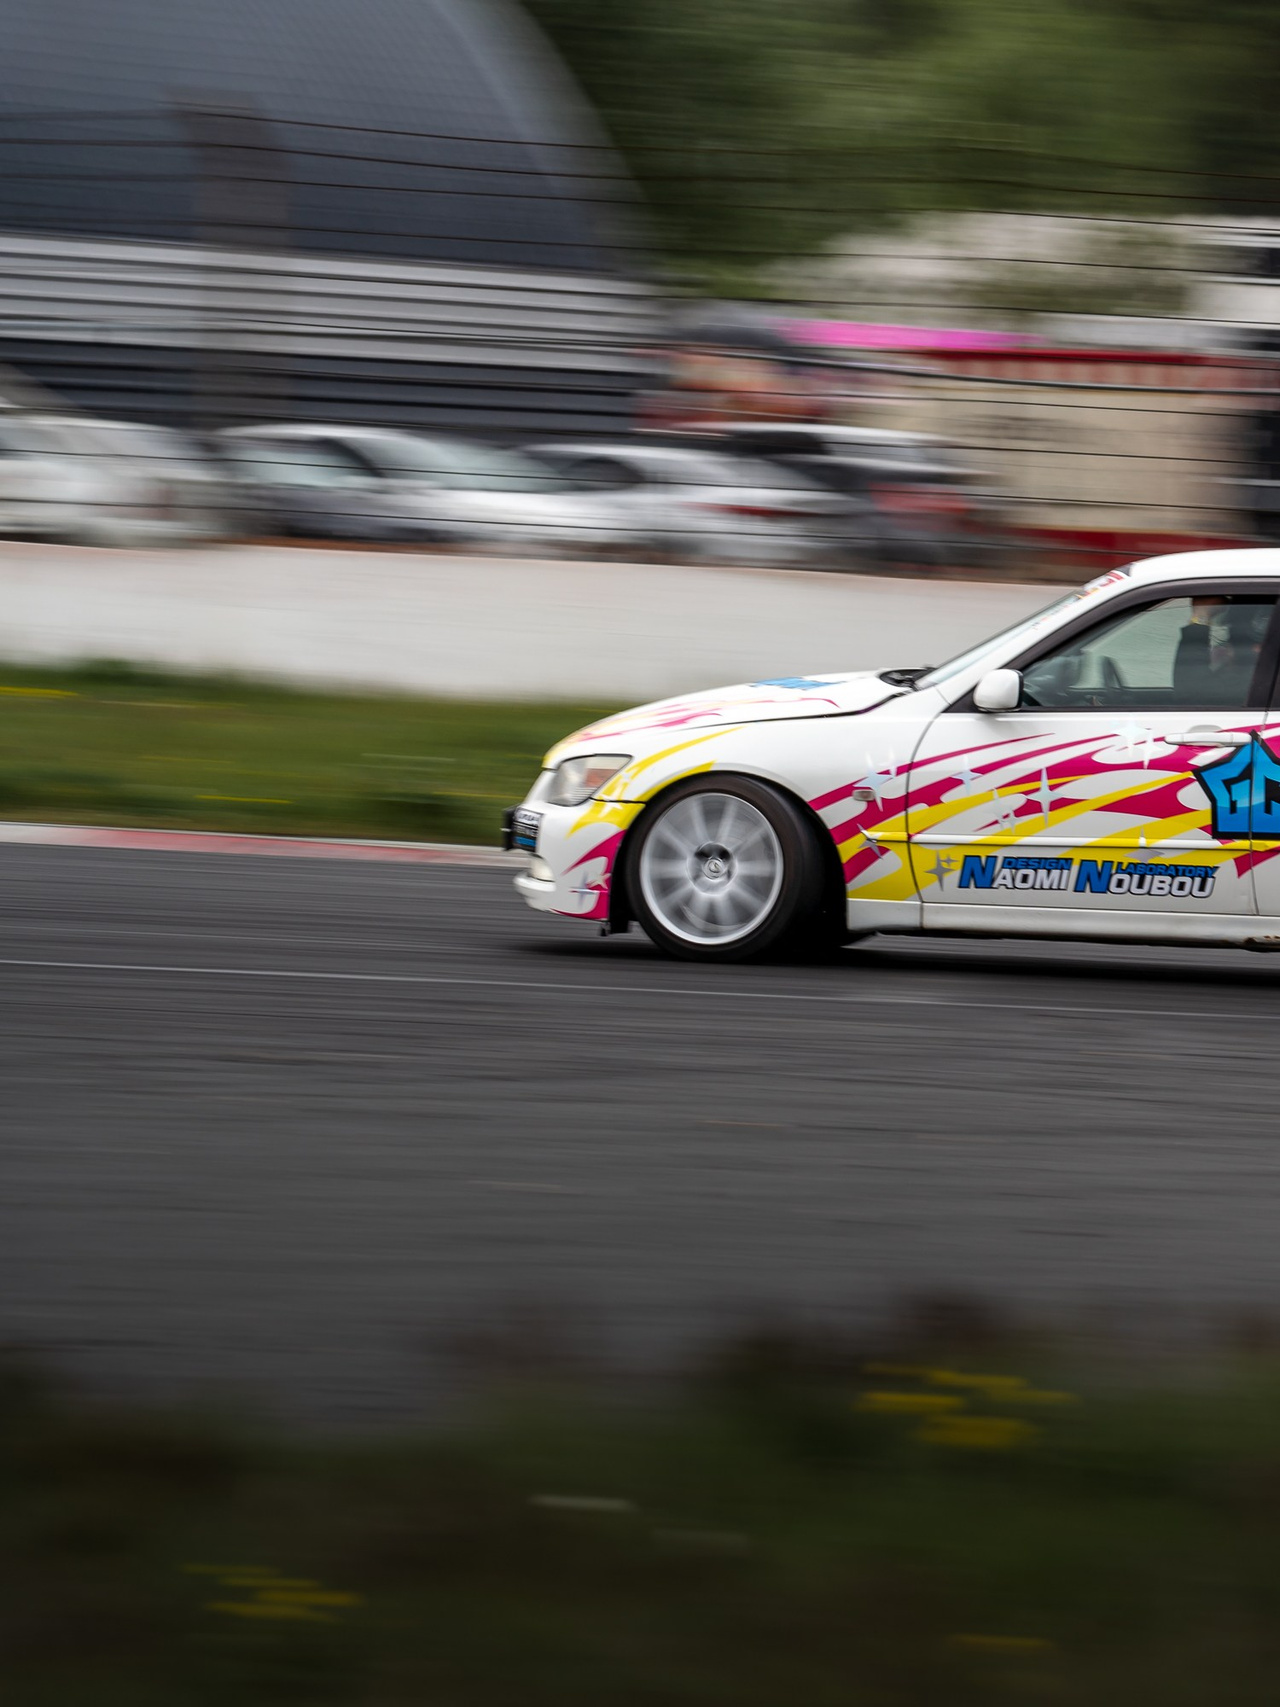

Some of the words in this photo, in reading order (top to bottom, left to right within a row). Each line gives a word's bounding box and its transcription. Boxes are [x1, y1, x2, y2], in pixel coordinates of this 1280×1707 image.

[958, 855, 1070, 890] NAOMI
[1074, 860, 1215, 898] NOUBOU
[1002, 857, 1073, 870] DESIGN
[1116, 862, 1219, 878] LABORATORY
